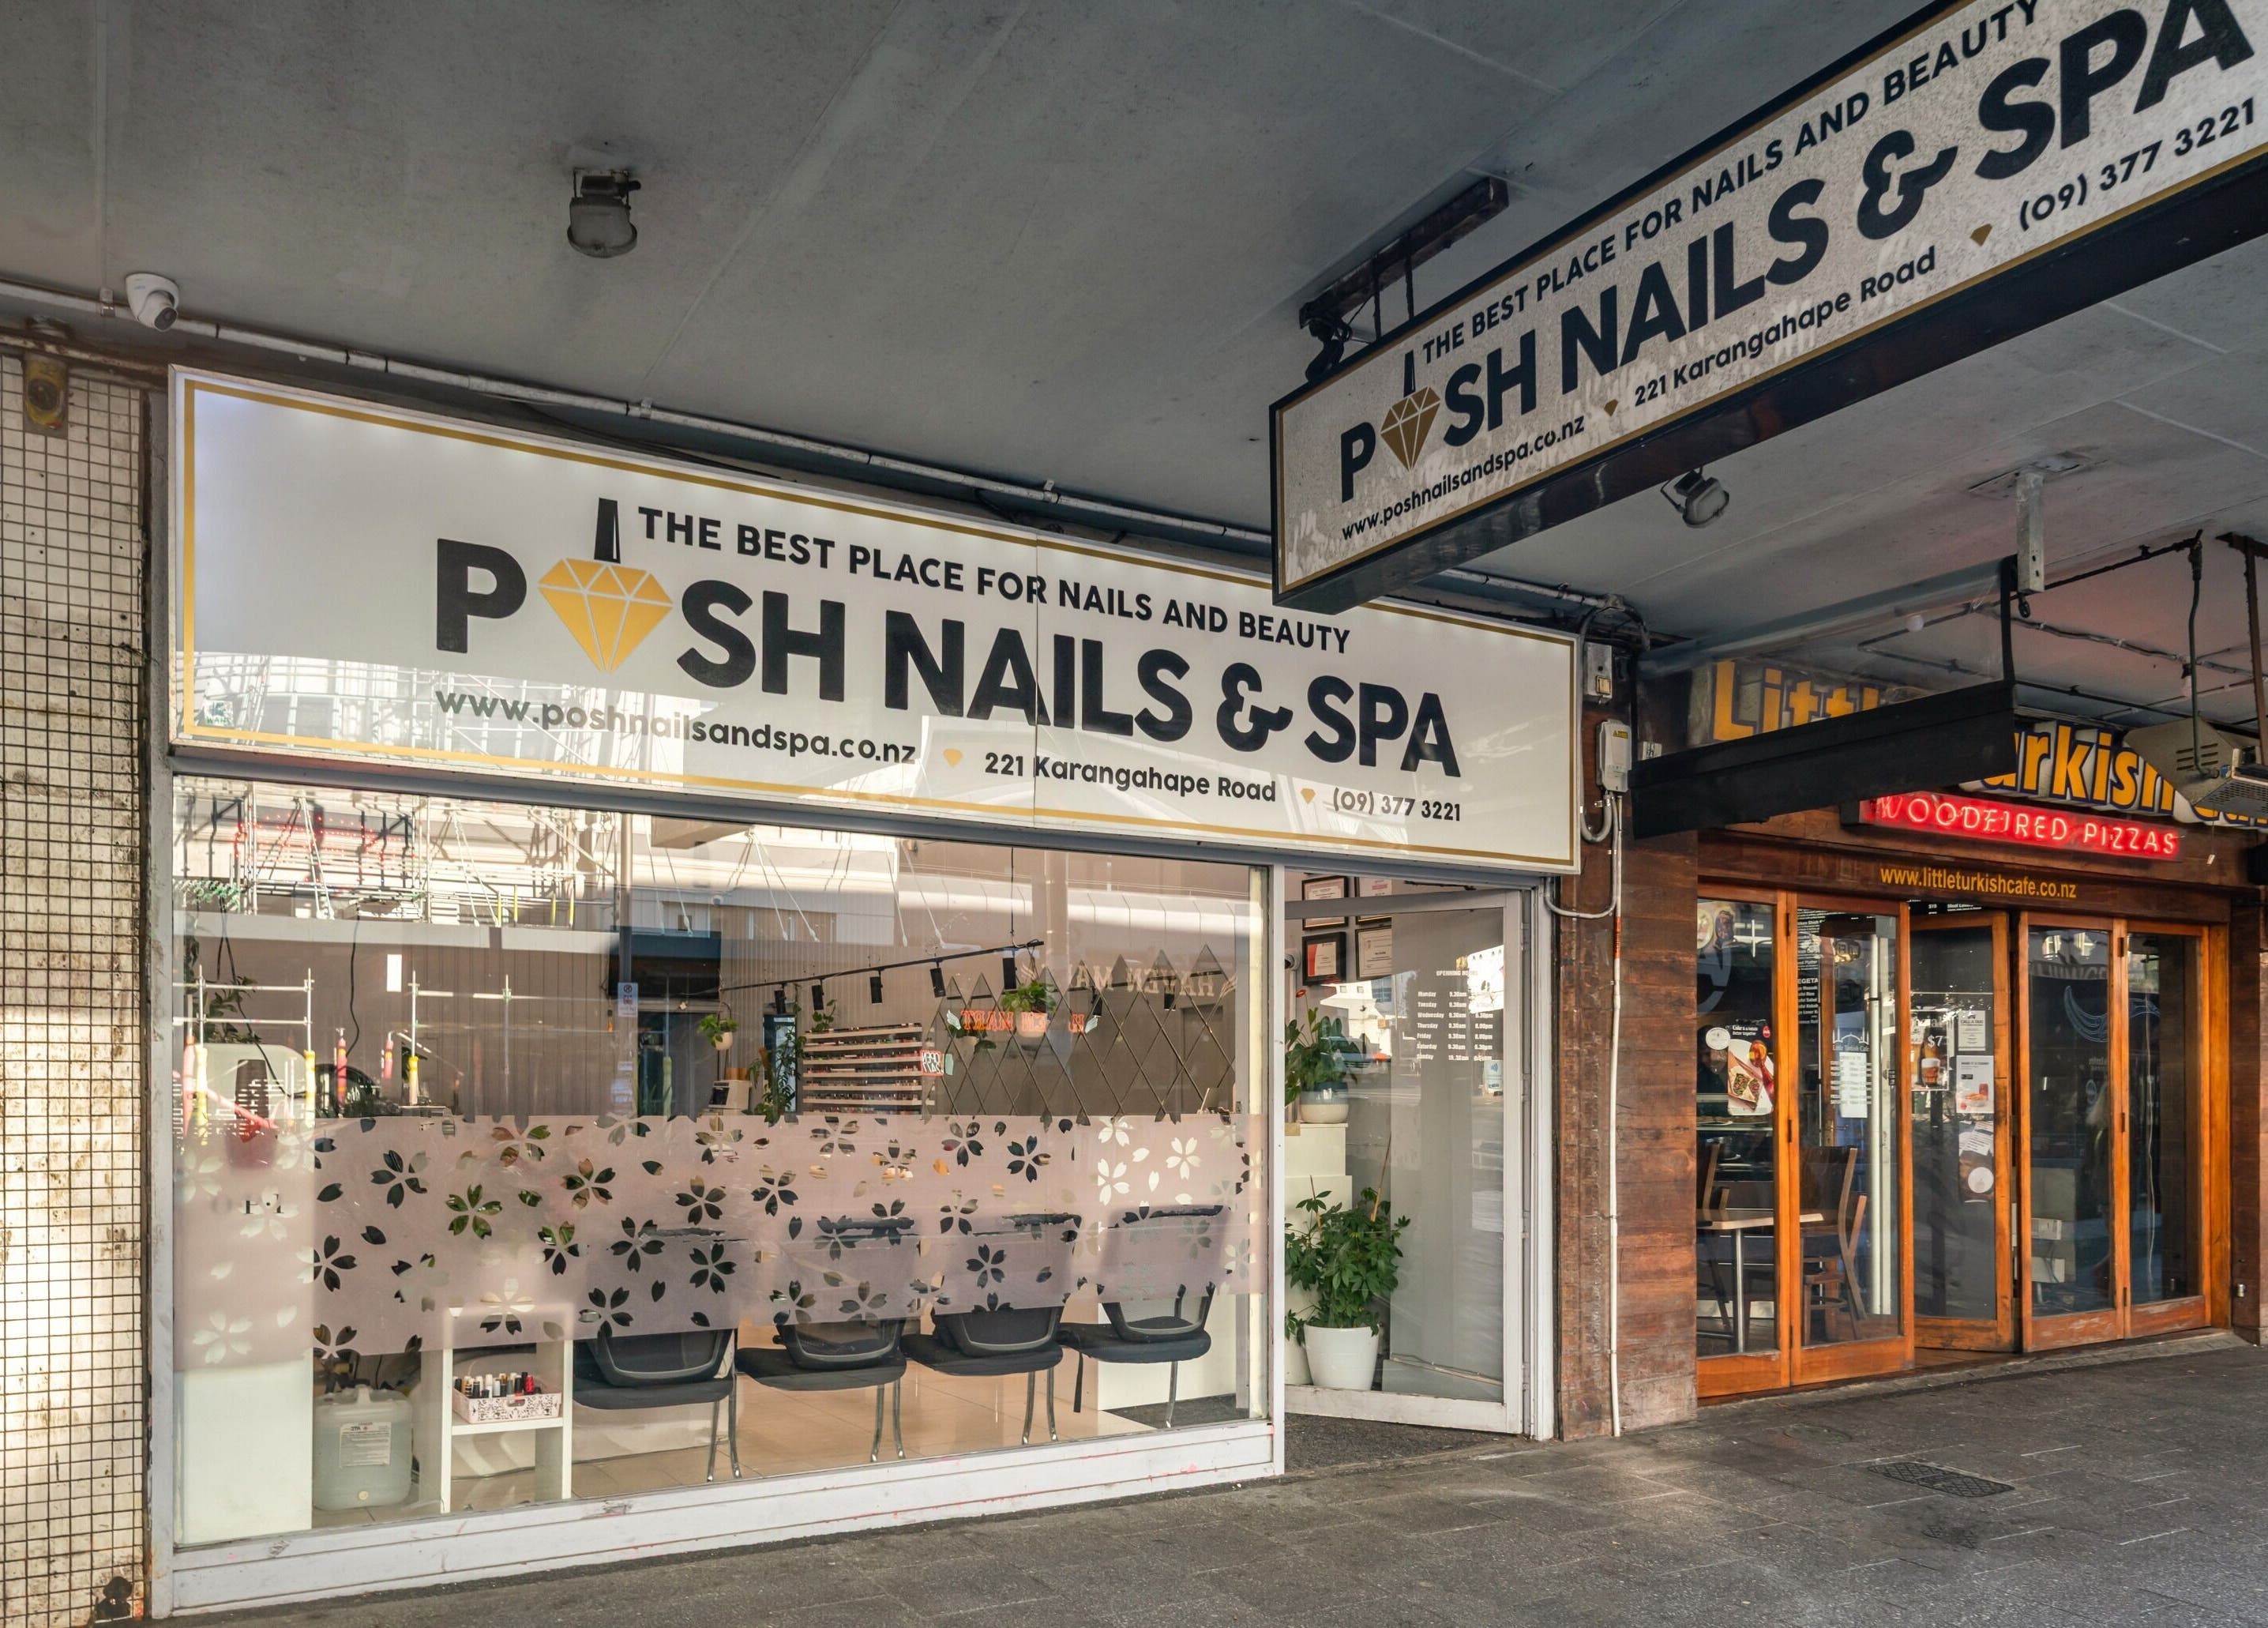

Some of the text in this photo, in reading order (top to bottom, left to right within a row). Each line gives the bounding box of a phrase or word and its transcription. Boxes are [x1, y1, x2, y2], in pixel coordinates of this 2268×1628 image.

[1422, 0, 2037, 366] THE BEST PLACE FOR NAILS AND BEAUTY
[1560, 178, 1830, 395] NAILS
[1856, 129, 1958, 240] &
[1975, 0, 2255, 180] SPA
[1342, 96, 2255, 541] www.poshnailsandspa.co.nz 221 Karangahape Road (09) 377 3221
[638, 506, 1350, 654] THE BEST PLACE FOR NAILS AND BEAUTY
[435, 689, 1461, 822] www.poshnailsandspa.co.nz 221 Karangahape Road (09) 377 3221
[884, 608, 1193, 752] NAILS
[1216, 662, 1294, 752] &
[1304, 675, 1461, 778] SPA
[1710, 660, 2175, 814] Litt rkish
[1879, 865, 2077, 899] www.littleturkishcafe.co.nz
[1880, 795, 2175, 855] WOODFIRED PIZZAS
